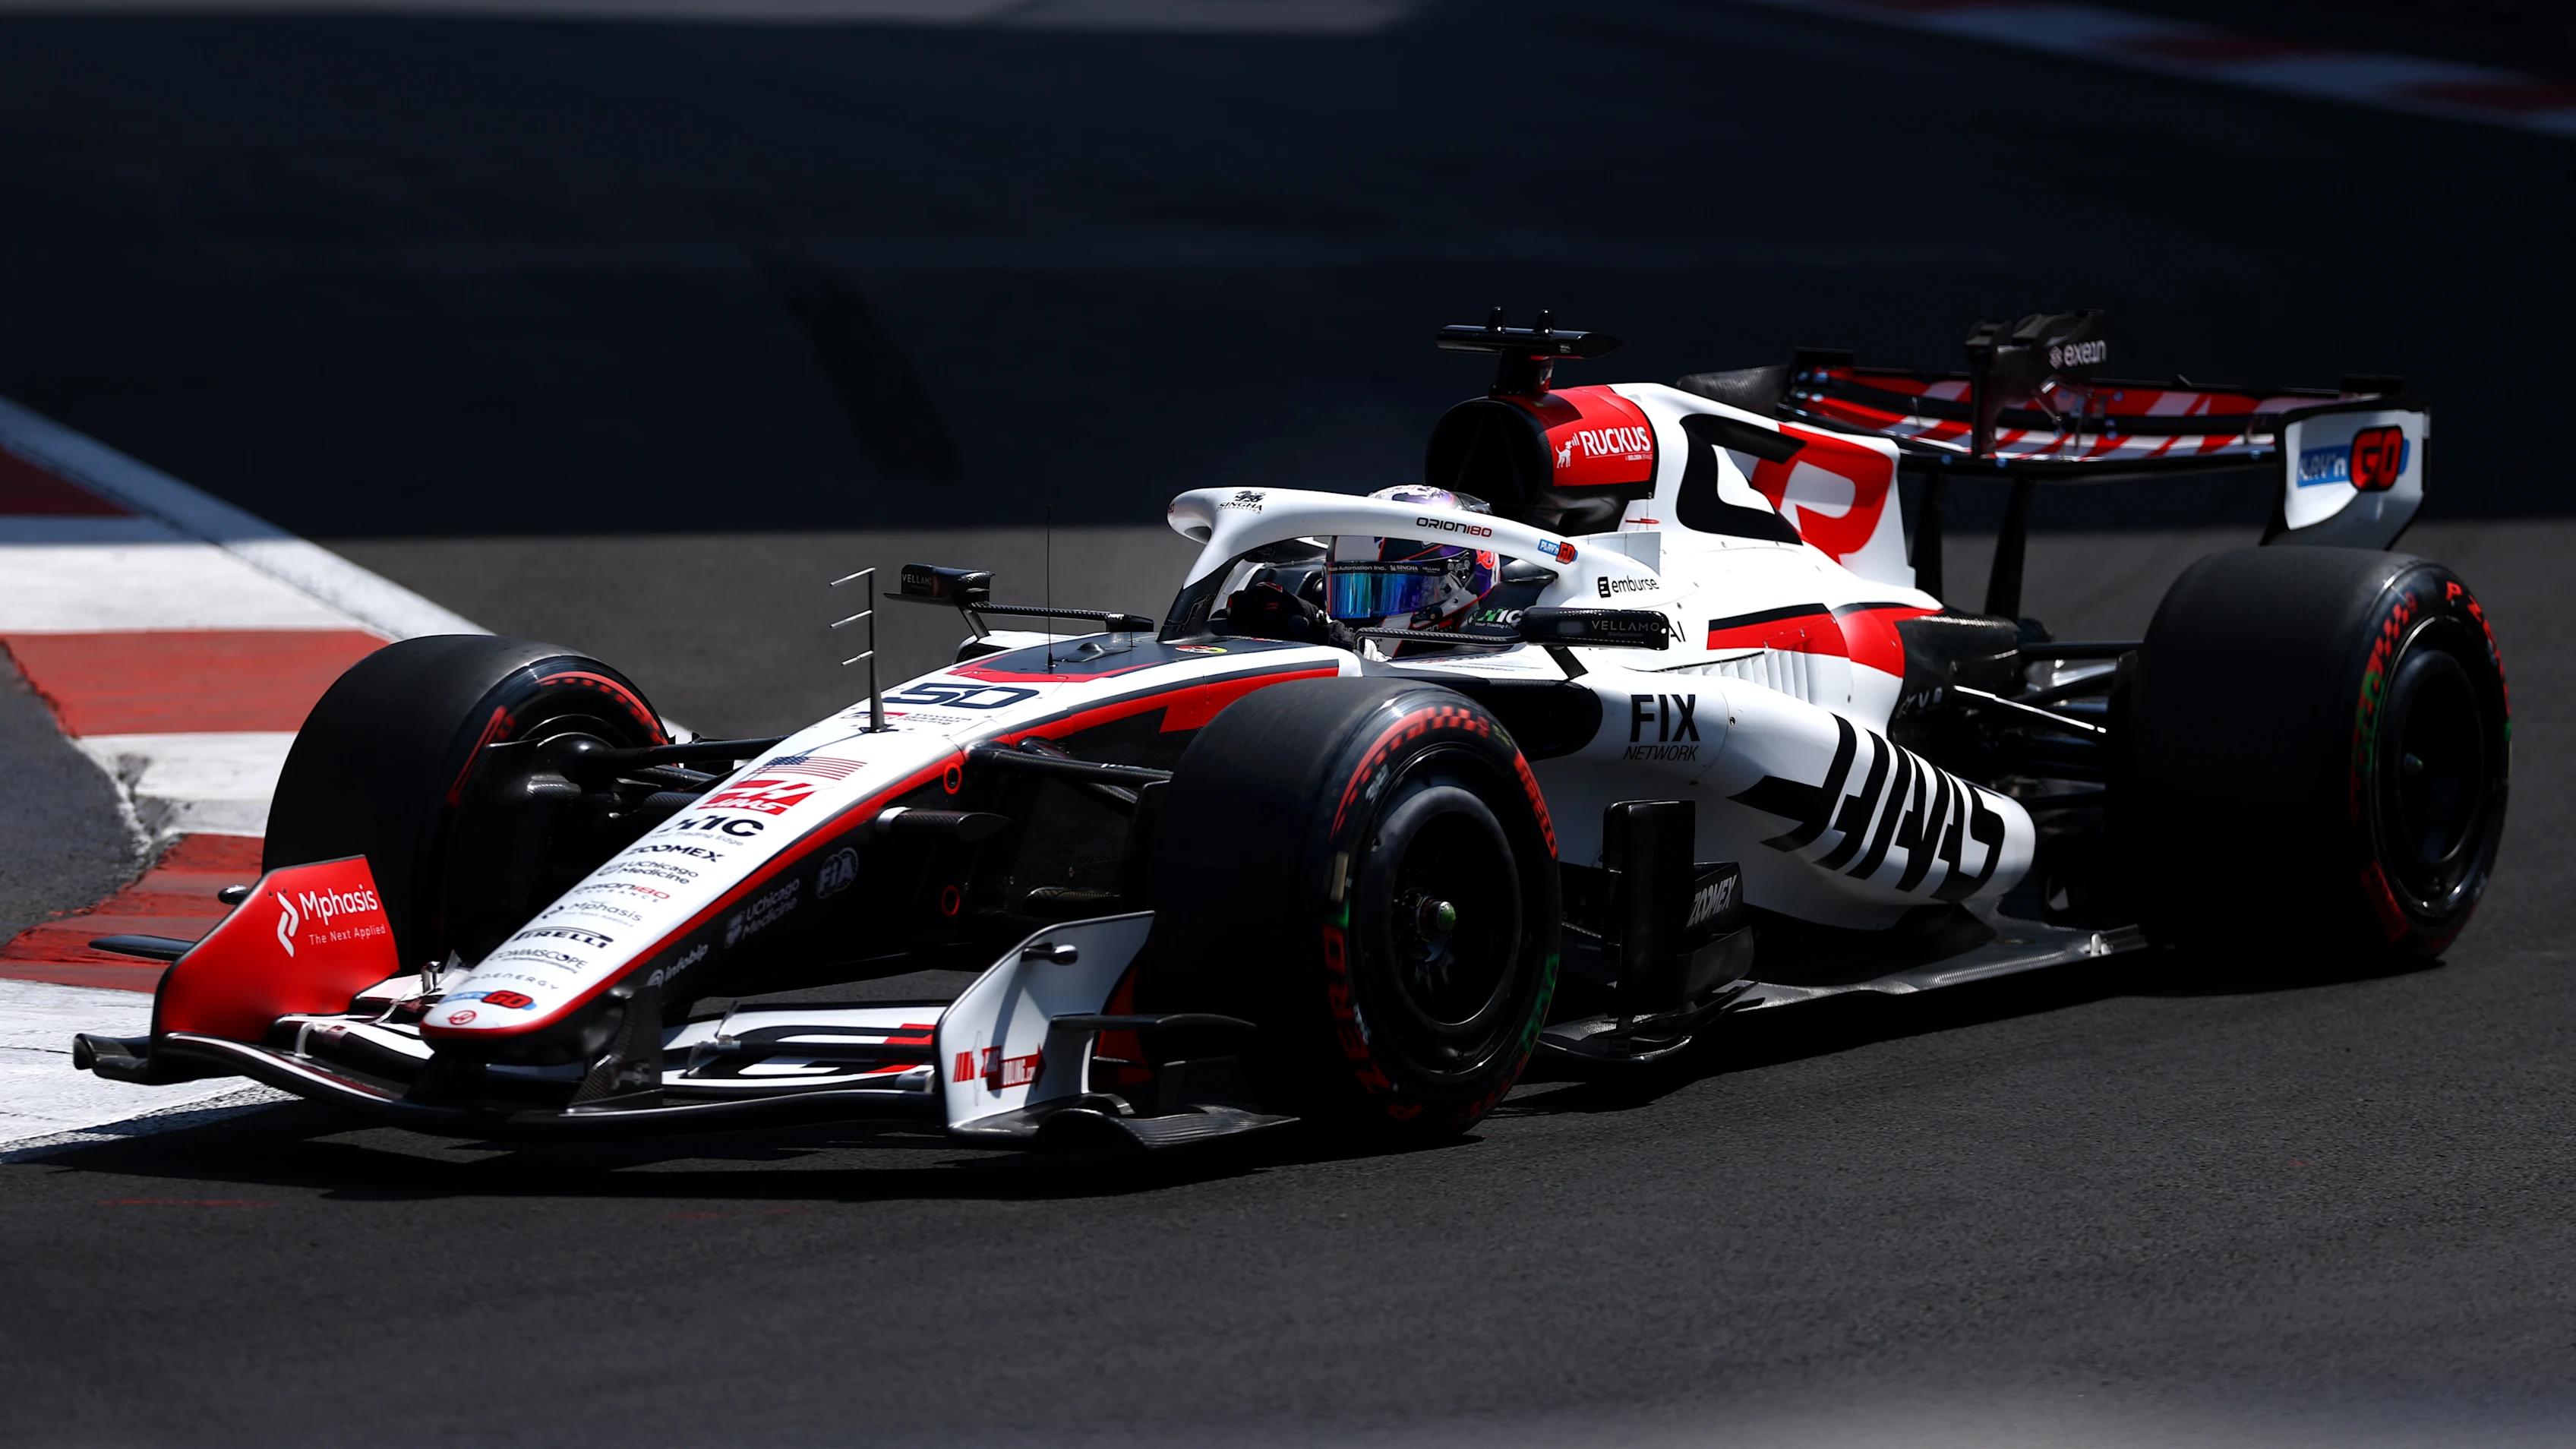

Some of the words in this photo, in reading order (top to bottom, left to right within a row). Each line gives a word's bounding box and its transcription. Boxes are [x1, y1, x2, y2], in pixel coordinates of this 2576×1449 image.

[1579, 426, 1651, 456] RUCKUS
[2350, 428, 2402, 490] GO
[1219, 502, 1262, 511] SINGHA
[1416, 517, 1492, 538] ORION180
[1556, 541, 1576, 564] GO
[1612, 576, 1660, 594] emburse
[1591, 620, 1660, 632] VELLAMO
[882, 683, 1040, 709] 50
[1630, 694, 1700, 743] FIX
[1623, 745, 1699, 761] NETWORK
[623, 844, 724, 862] ZOOMEX
[617, 867, 690, 884] Medicine
[627, 860, 699, 877] UChicago
[298, 884, 378, 926] Mphasis
[568, 901, 642, 921] Mphasis
[1686, 874, 1738, 928] ZOOMEX
[309, 934, 327, 945] The
[330, 930, 352, 942] Next
[354, 923, 386, 940] Applied
[513, 927, 614, 949] PIRELLI
[665, 943, 709, 982] infobip
